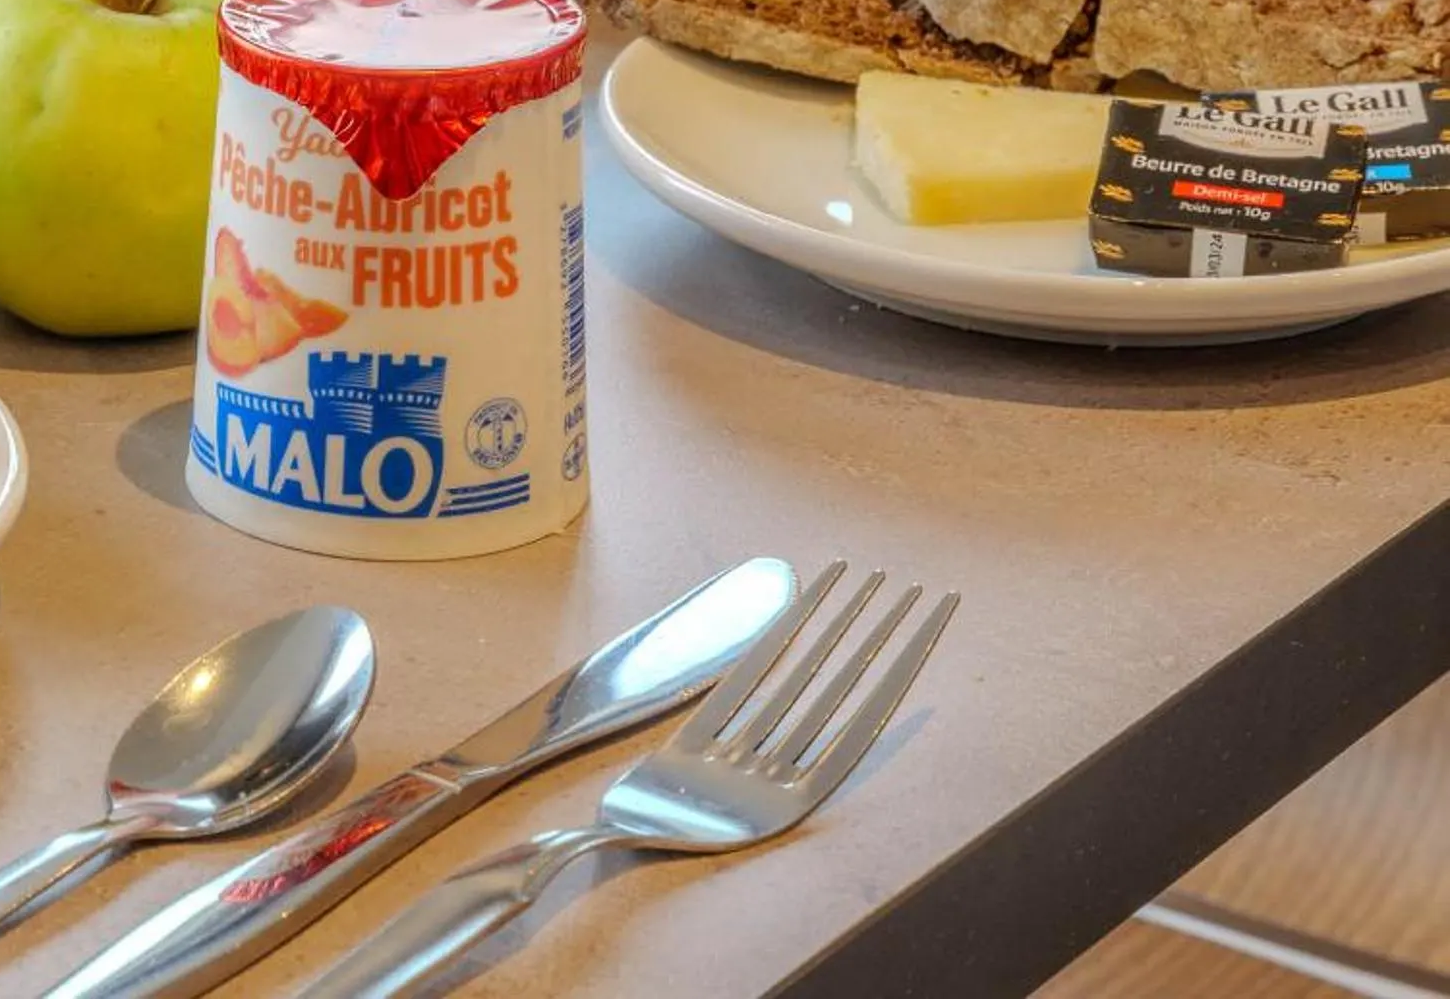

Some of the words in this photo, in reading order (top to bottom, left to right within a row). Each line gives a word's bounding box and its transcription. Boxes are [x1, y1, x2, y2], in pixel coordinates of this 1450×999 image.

[1272, 96, 1319, 114] Le
[1327, 88, 1408, 112] Gall
[1176, 105, 1224, 122] Le
[1233, 109, 1315, 137] Gall
[1131, 155, 1203, 176] Beurre
[1208, 164, 1236, 181] de
[1241, 168, 1341, 193] Bretagne
[1193, 185, 1266, 205] Demi-sel
[1179, 201, 1211, 214] Poids
[1244, 207, 1271, 222] 10g
[294, 236, 346, 270] aux
[352, 235, 518, 309] FRUITS
[224, 413, 434, 514] MALO
